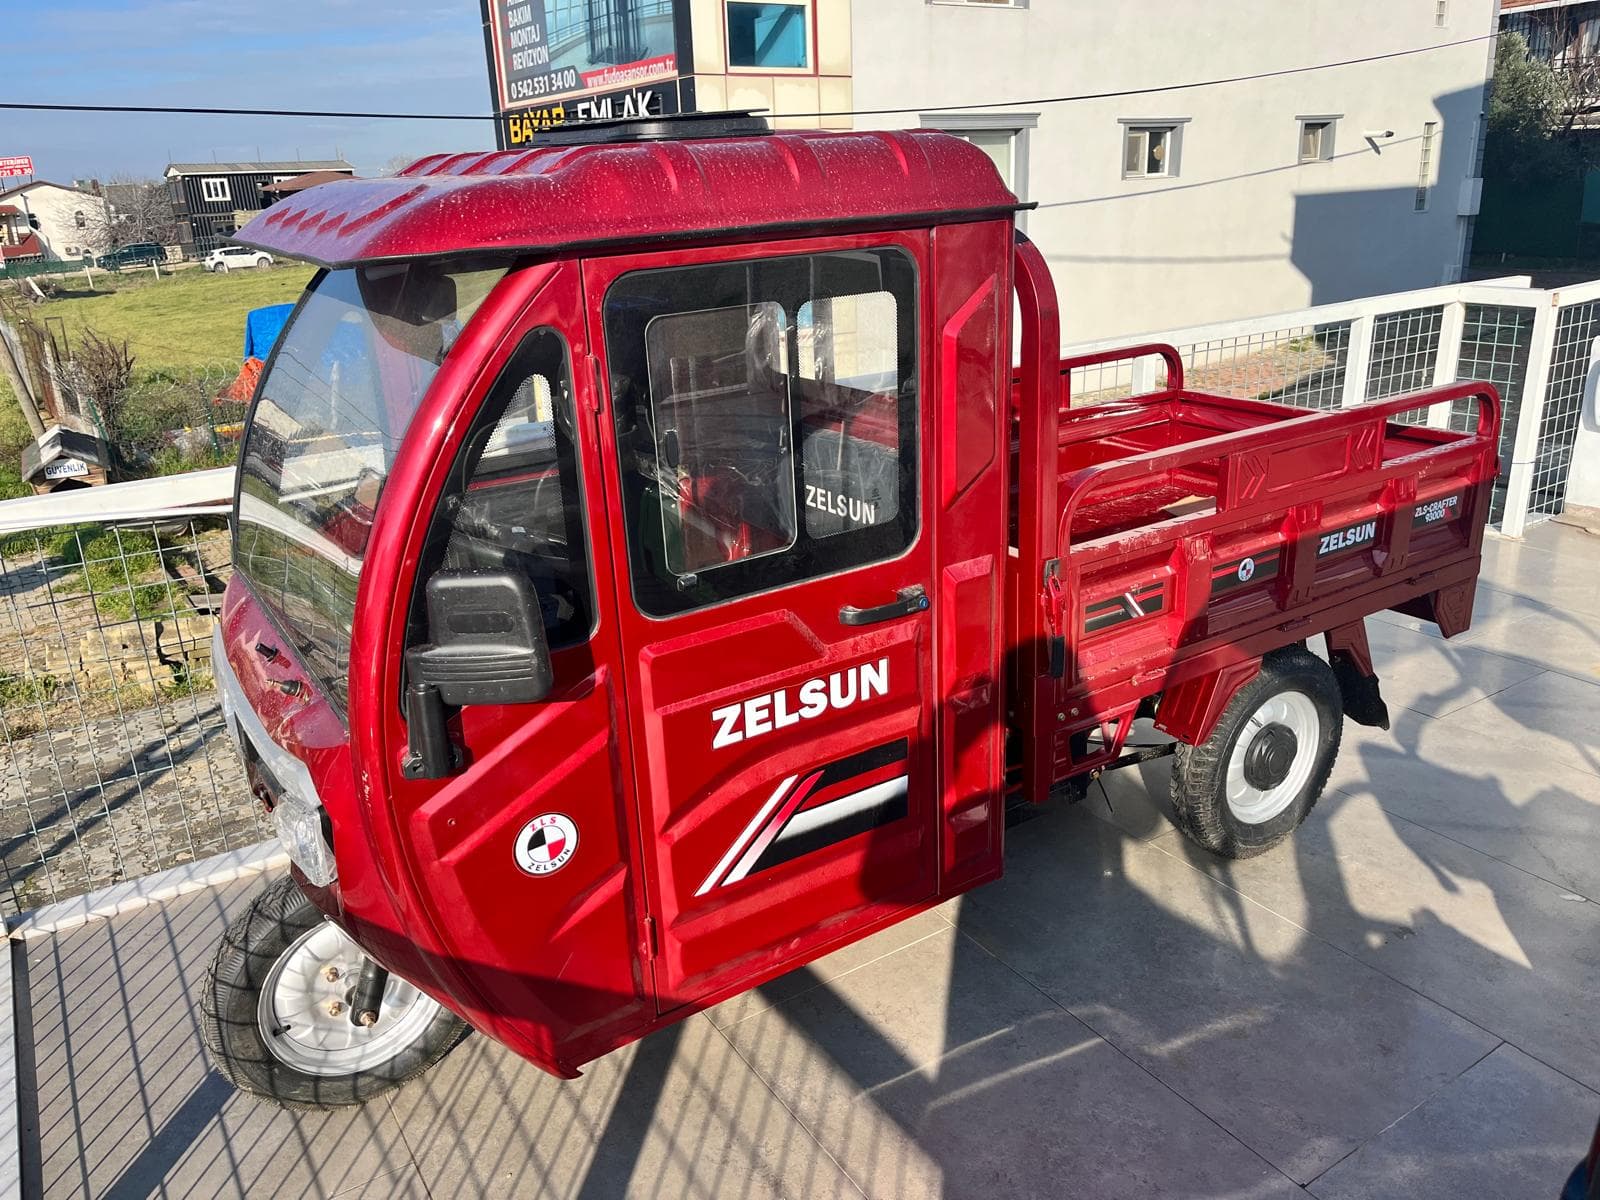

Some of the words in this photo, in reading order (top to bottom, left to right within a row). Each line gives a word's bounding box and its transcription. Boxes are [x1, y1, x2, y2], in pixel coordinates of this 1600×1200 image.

[508, 4, 532, 28] BAKIM
[510, 23, 540, 49] MONTAJ
[512, 45, 549, 71] REVİZYON
[805, 484, 875, 524] ZELSUN
[1414, 495, 1458, 518] ZLS-CRAFTER
[1318, 521, 1377, 555] ZELSUN
[711, 656, 890, 751] ZELSUN
[529, 816, 557, 832] ZLS
[528, 848, 571, 872] ZELSUN
